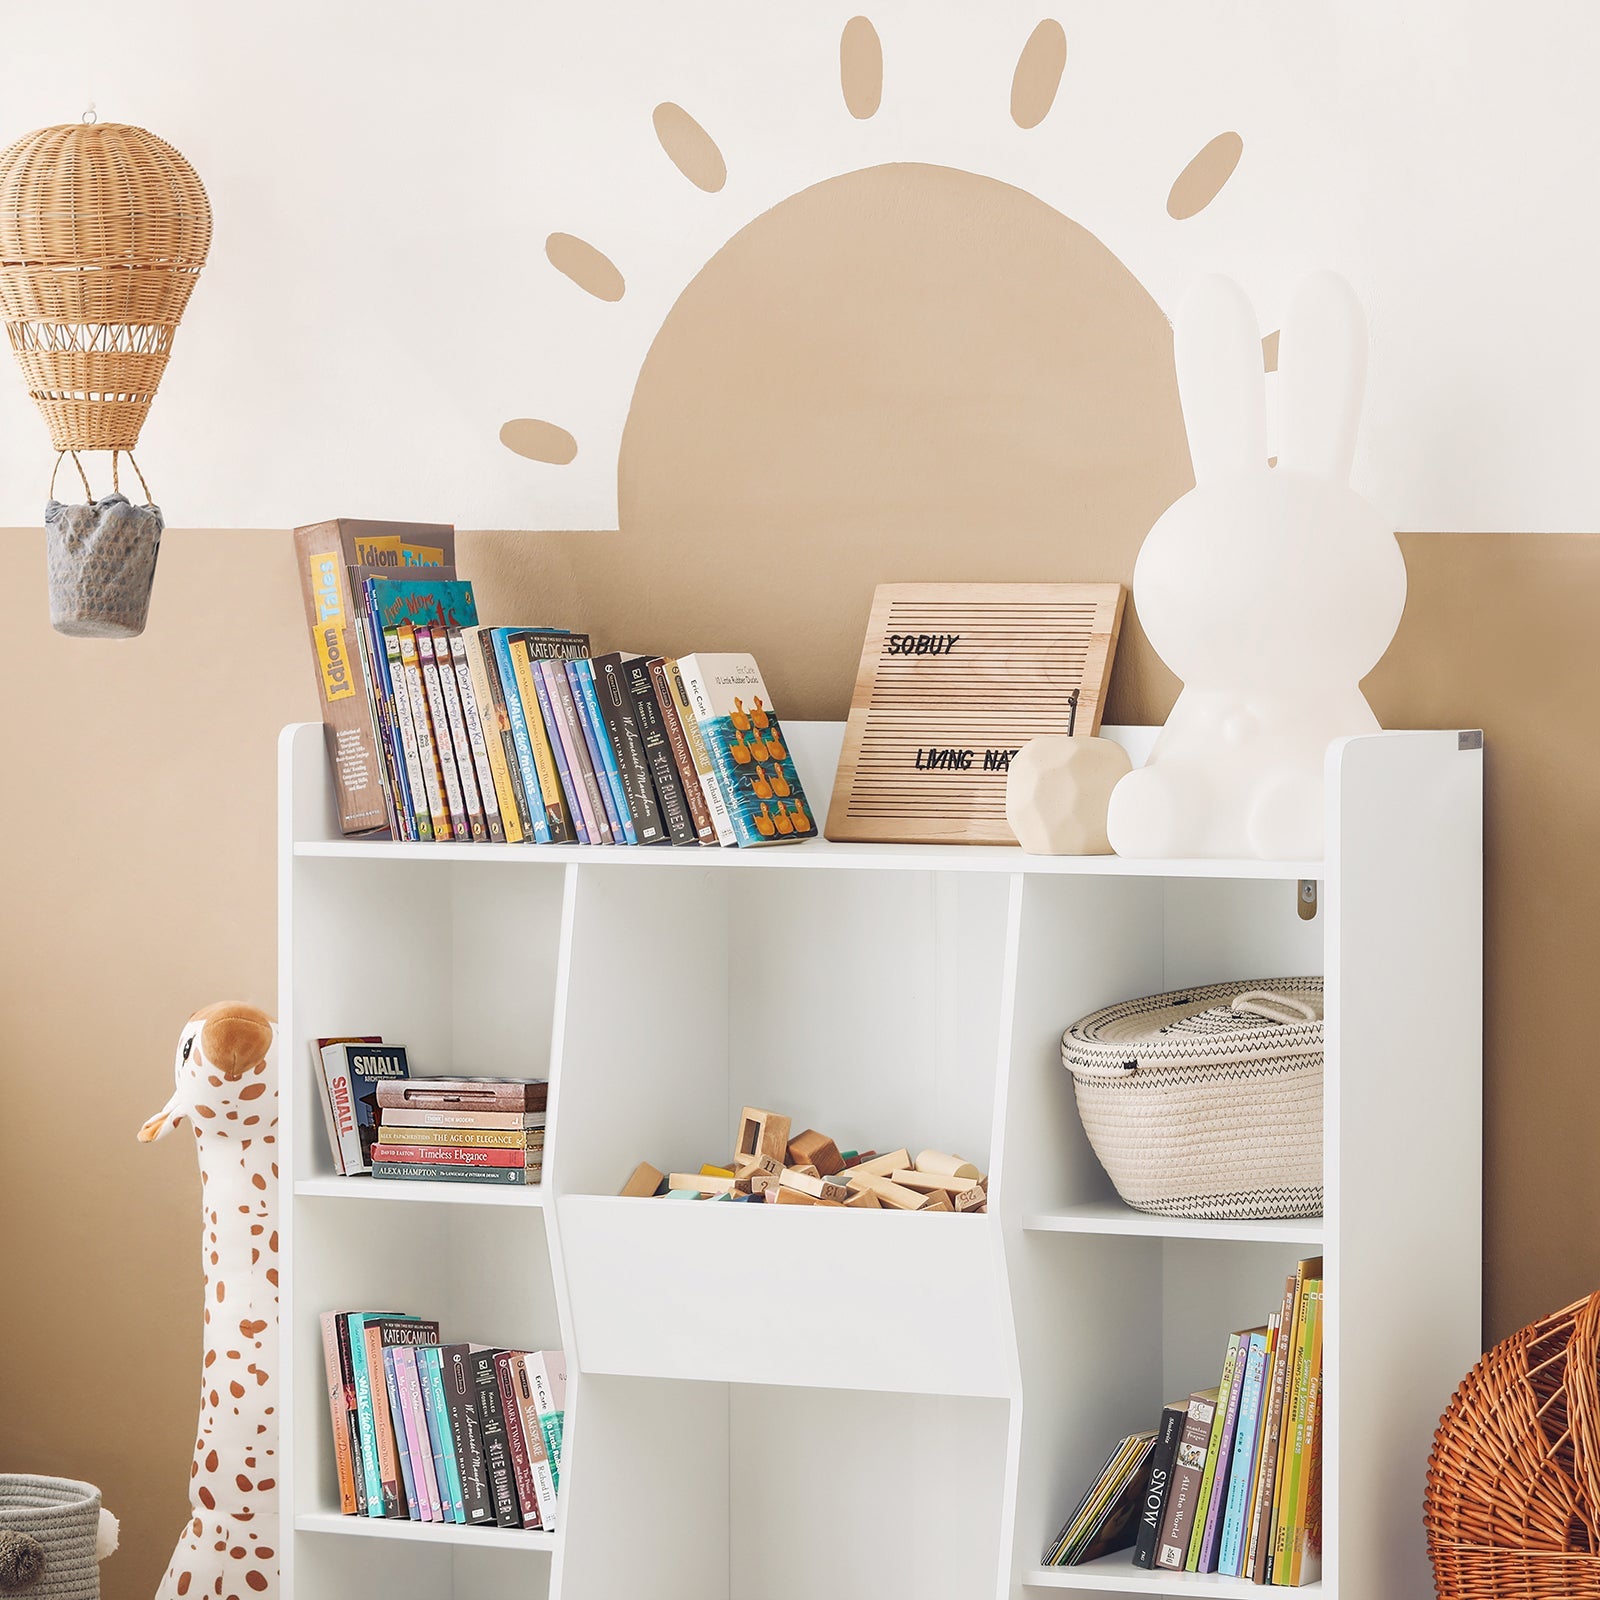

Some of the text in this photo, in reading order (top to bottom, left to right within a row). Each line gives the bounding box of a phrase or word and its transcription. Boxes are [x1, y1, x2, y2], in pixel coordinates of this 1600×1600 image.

[359, 545, 398, 566] Idiom
[319, 561, 350, 695] Idiom Tales
[530, 642, 548, 658] KATE
[888, 634, 960, 656] SOBUY
[391, 664, 403, 683] Diary
[406, 667, 418, 686] Diary
[441, 666, 453, 685] Diary
[457, 667, 471, 691] Diary
[396, 694, 408, 715] Wimpy
[412, 697, 424, 719] Wimpy
[425, 666, 437, 685] Diary
[431, 696, 443, 718] Wimpy
[437, 717, 445, 729] Kid
[447, 696, 459, 718] Wimpy
[689, 678, 708, 716] Eric Carle
[402, 715, 410, 726] Kid
[417, 719, 426, 730] Kid
[452, 718, 461, 729] Kid
[464, 705, 479, 732] Wimpy
[636, 700, 650, 729] HOSSEINI
[644, 701, 656, 724] KHALED
[471, 731, 483, 745] Kid
[608, 719, 617, 733] OF
[664, 707, 688, 764] MARK TWAIN
[417, 734, 425, 748] DAYS
[422, 733, 430, 747] DOG
[506, 692, 525, 730] WALK
[518, 753, 538, 795] moons
[611, 735, 627, 769] HUMAN
[622, 724, 646, 770] Somerset
[683, 712, 711, 768] SHAKESPEARE
[915, 748, 974, 771] LIVING
[709, 736, 722, 757] Little
[716, 757, 732, 786] Rubber
[725, 785, 740, 810] Ducks
[621, 772, 640, 819] BONDAGE
[628, 770, 657, 818] Maugham
[652, 755, 686, 832] KITE RUNNER
[690, 780, 699, 792] The
[704, 776, 725, 816] Richard III
[353, 1056, 404, 1075] SMALL
[332, 1076, 353, 1137] SMALL
[476, 1135, 512, 1144] ELEGANCE
[419, 1148, 452, 1160] Timeless
[454, 1149, 488, 1163] Elegance
[764, 1160, 776, 1173] 11
[379, 1167, 401, 1175] ALEXA
[402, 1168, 437, 1177] HAMPTON
[960, 1189, 976, 1204] 25
[383, 1329, 400, 1344] KATE
[356, 1375, 370, 1409] WALK
[479, 1390, 489, 1417] HOSSEINI
[486, 1391, 496, 1413] KHALED
[534, 1375, 548, 1410] Eric Carle
[464, 1413, 480, 1454] Somerset
[504, 1398, 522, 1452] MARK TWAIN
[523, 1405, 544, 1457] SHAKESPEARE
[547, 1429, 558, 1449] Little
[362, 1433, 376, 1471] moons
[451, 1406, 469, 1499] OF HUMAN BONDAGE
[464, 1455, 486, 1499] Maugham
[488, 1442, 512, 1514] KITE RUNNER
[521, 1468, 529, 1478] The
[536, 1465, 550, 1502] Richard III
[1141, 1467, 1167, 1528] SNOW
[1170, 1474, 1190, 1539] All the World
